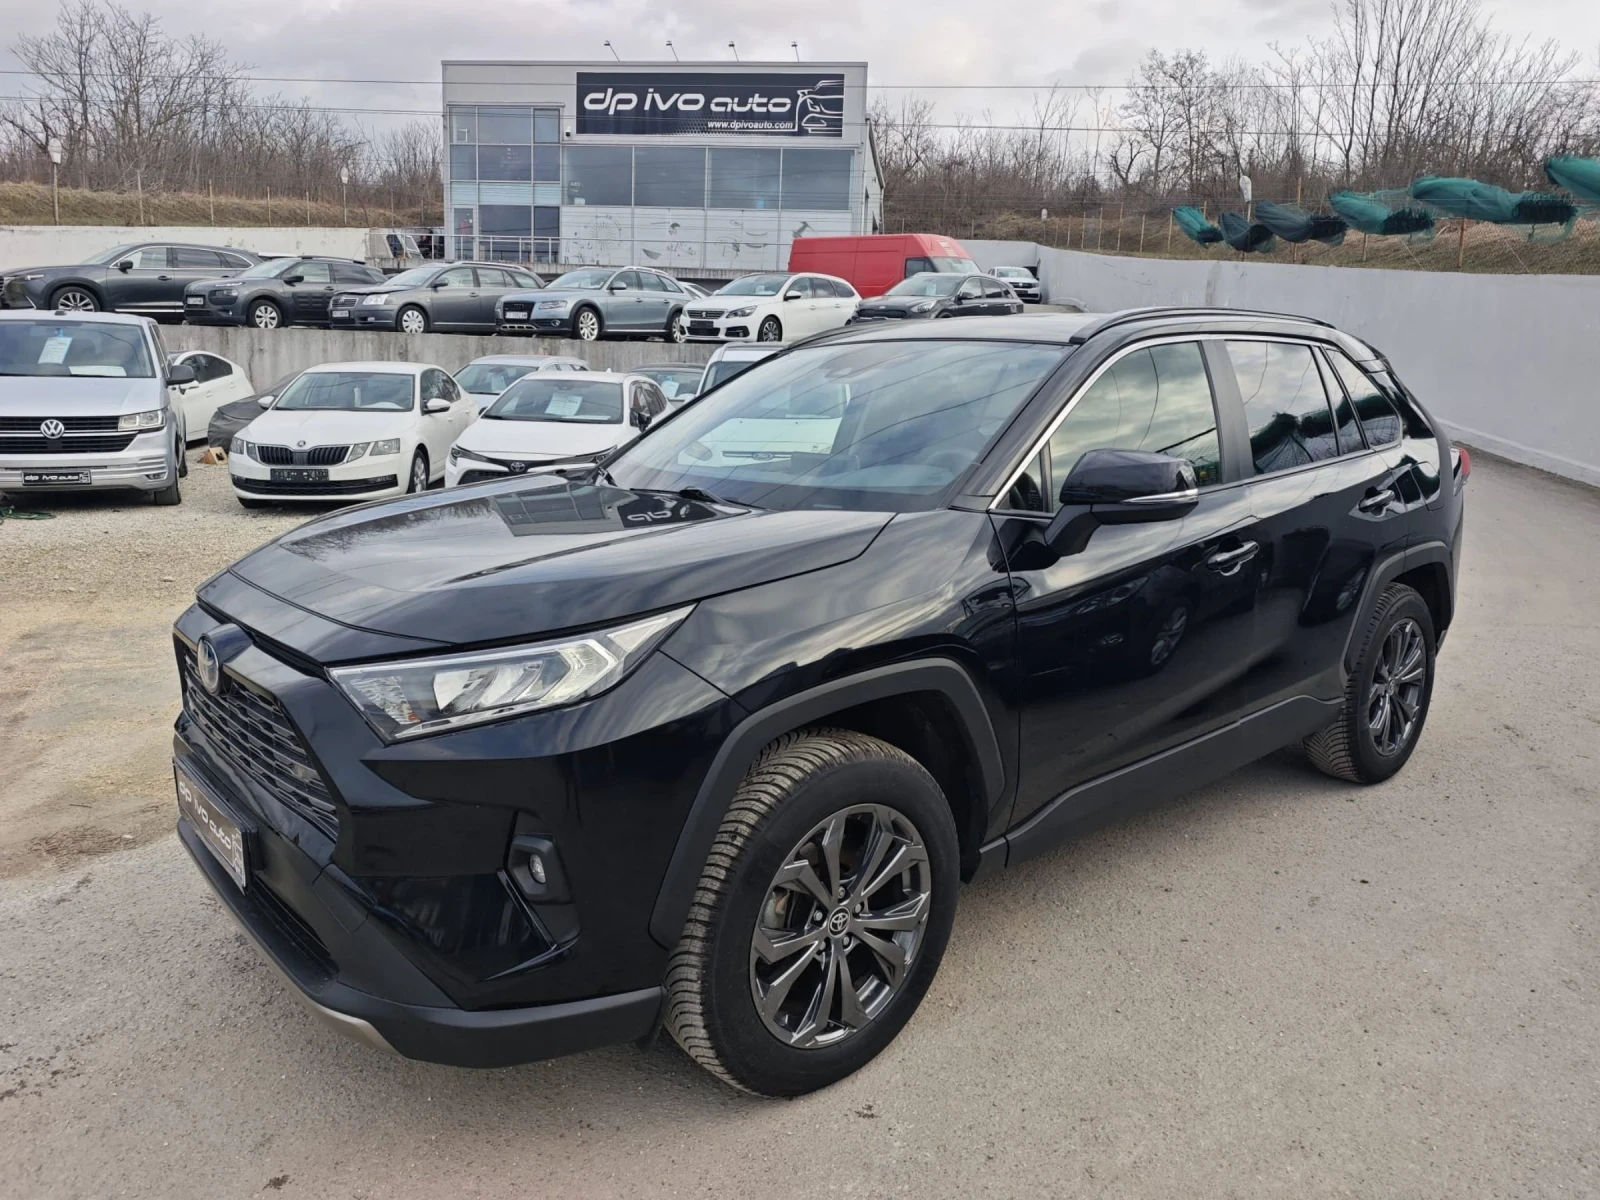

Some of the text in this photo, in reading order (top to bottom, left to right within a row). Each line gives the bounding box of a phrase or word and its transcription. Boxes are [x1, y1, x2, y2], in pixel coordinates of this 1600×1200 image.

[583, 88, 792, 115] dp ivo auto
[707, 119, 794, 131] www.dpivoauto.com
[179, 781, 192, 803] dp
[208, 819, 232, 850] auto
